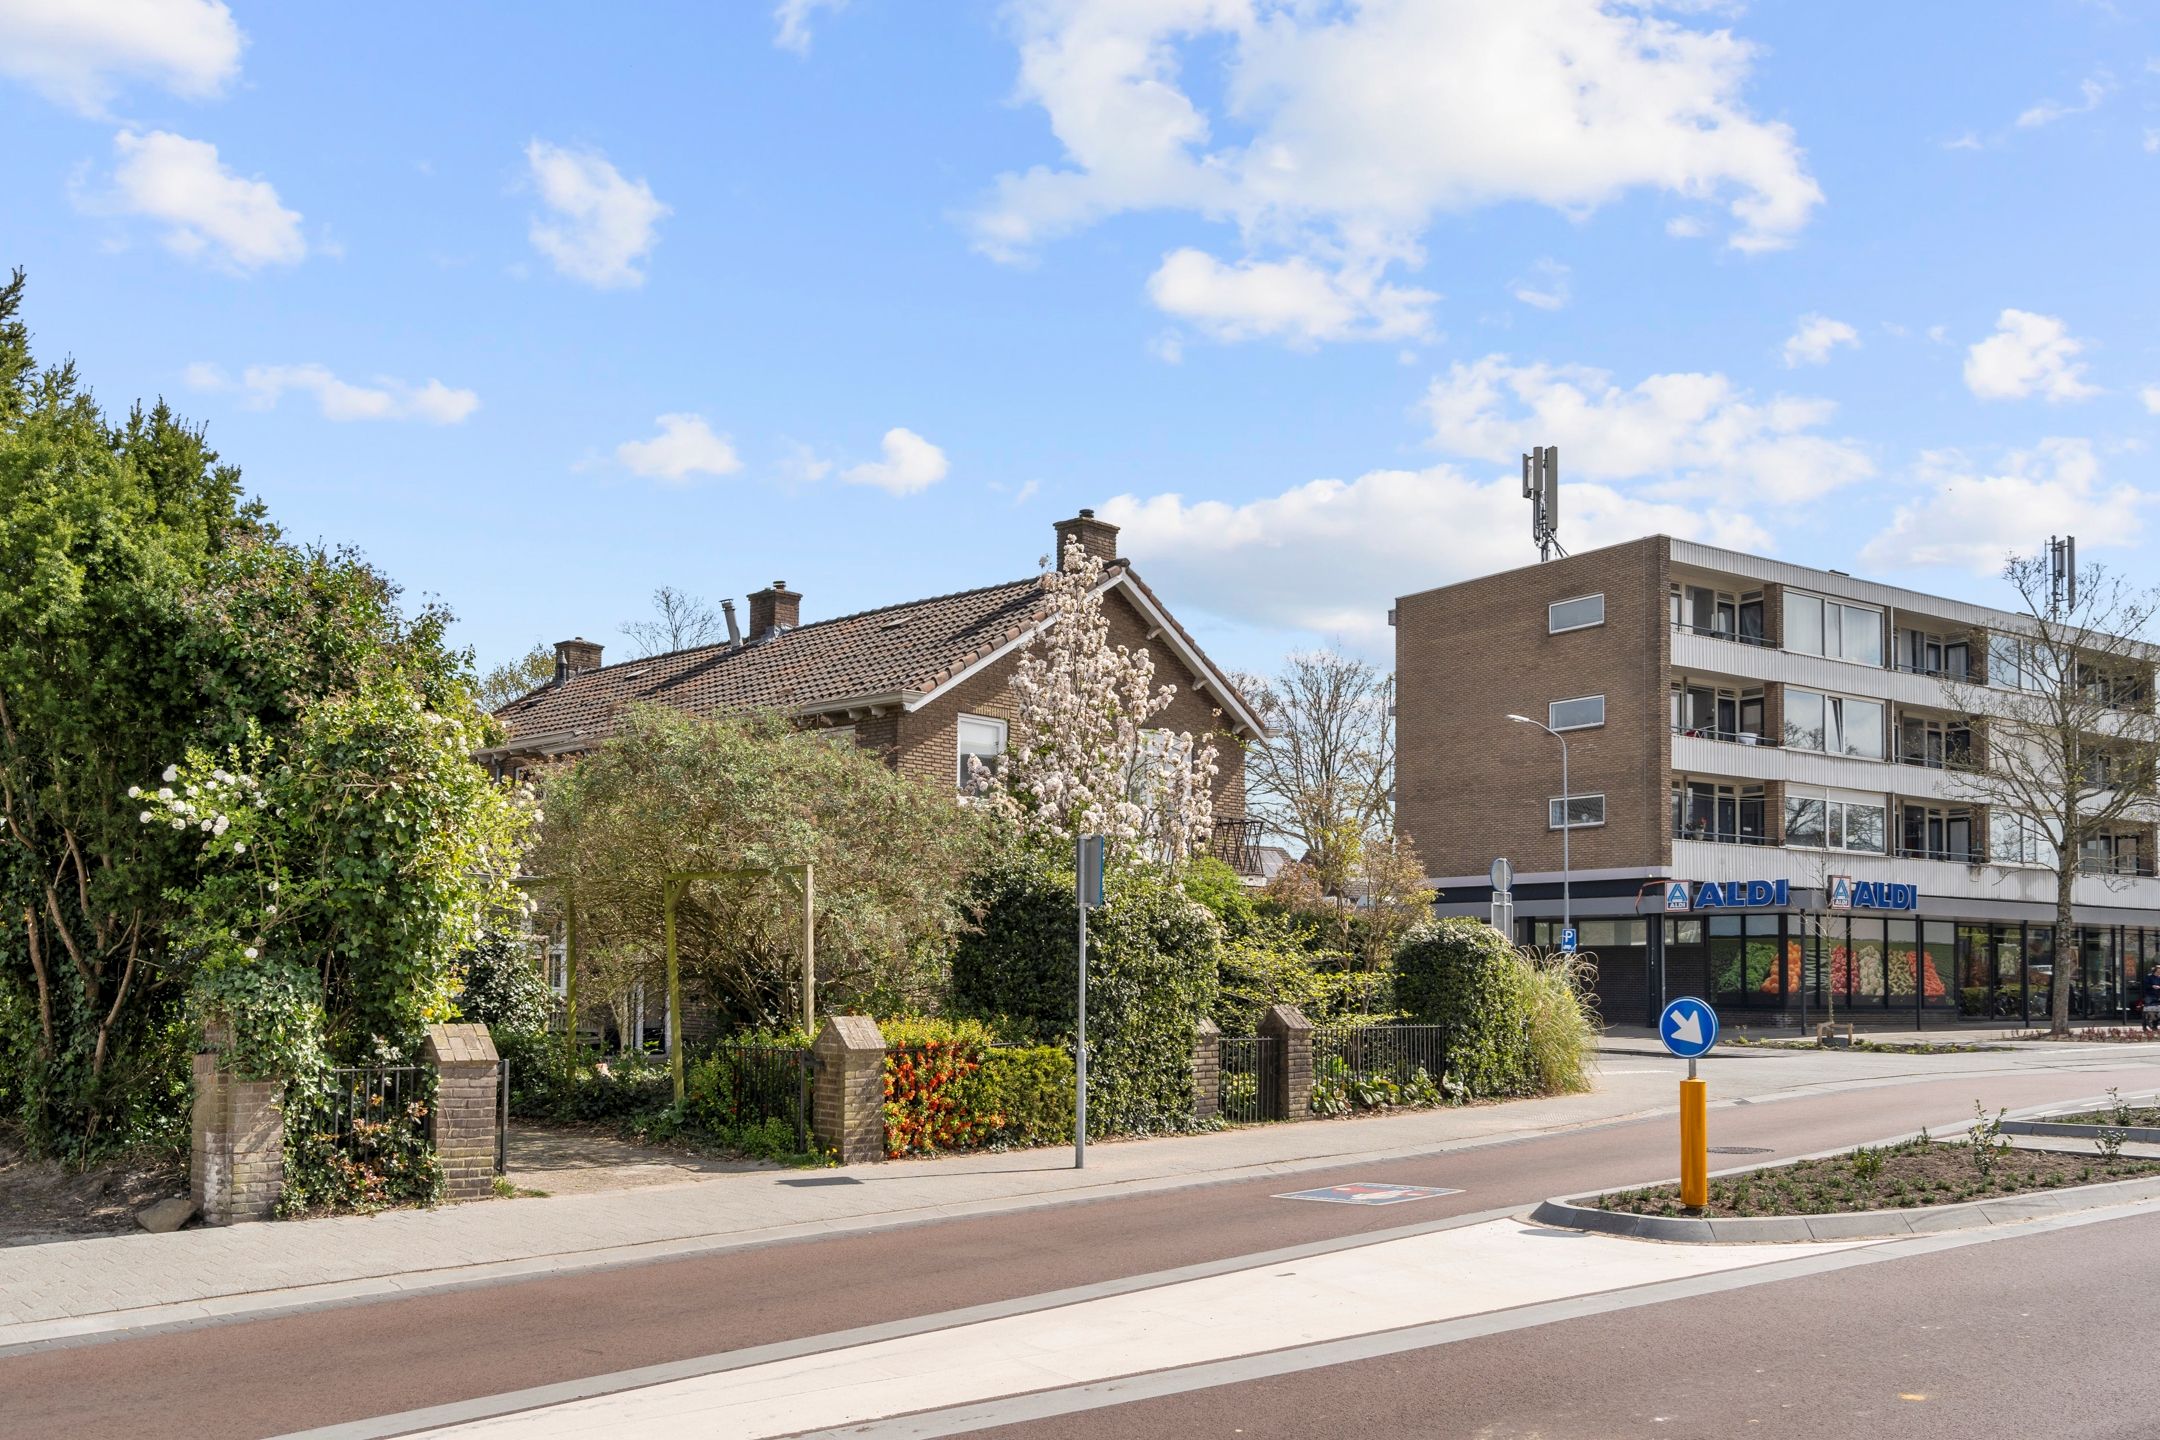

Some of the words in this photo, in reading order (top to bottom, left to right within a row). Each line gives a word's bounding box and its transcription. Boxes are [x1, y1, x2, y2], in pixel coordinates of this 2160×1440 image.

[1693, 879, 1788, 908] ALDI
[1852, 881, 1917, 910] ALDI
[1565, 930, 1574, 943] P
